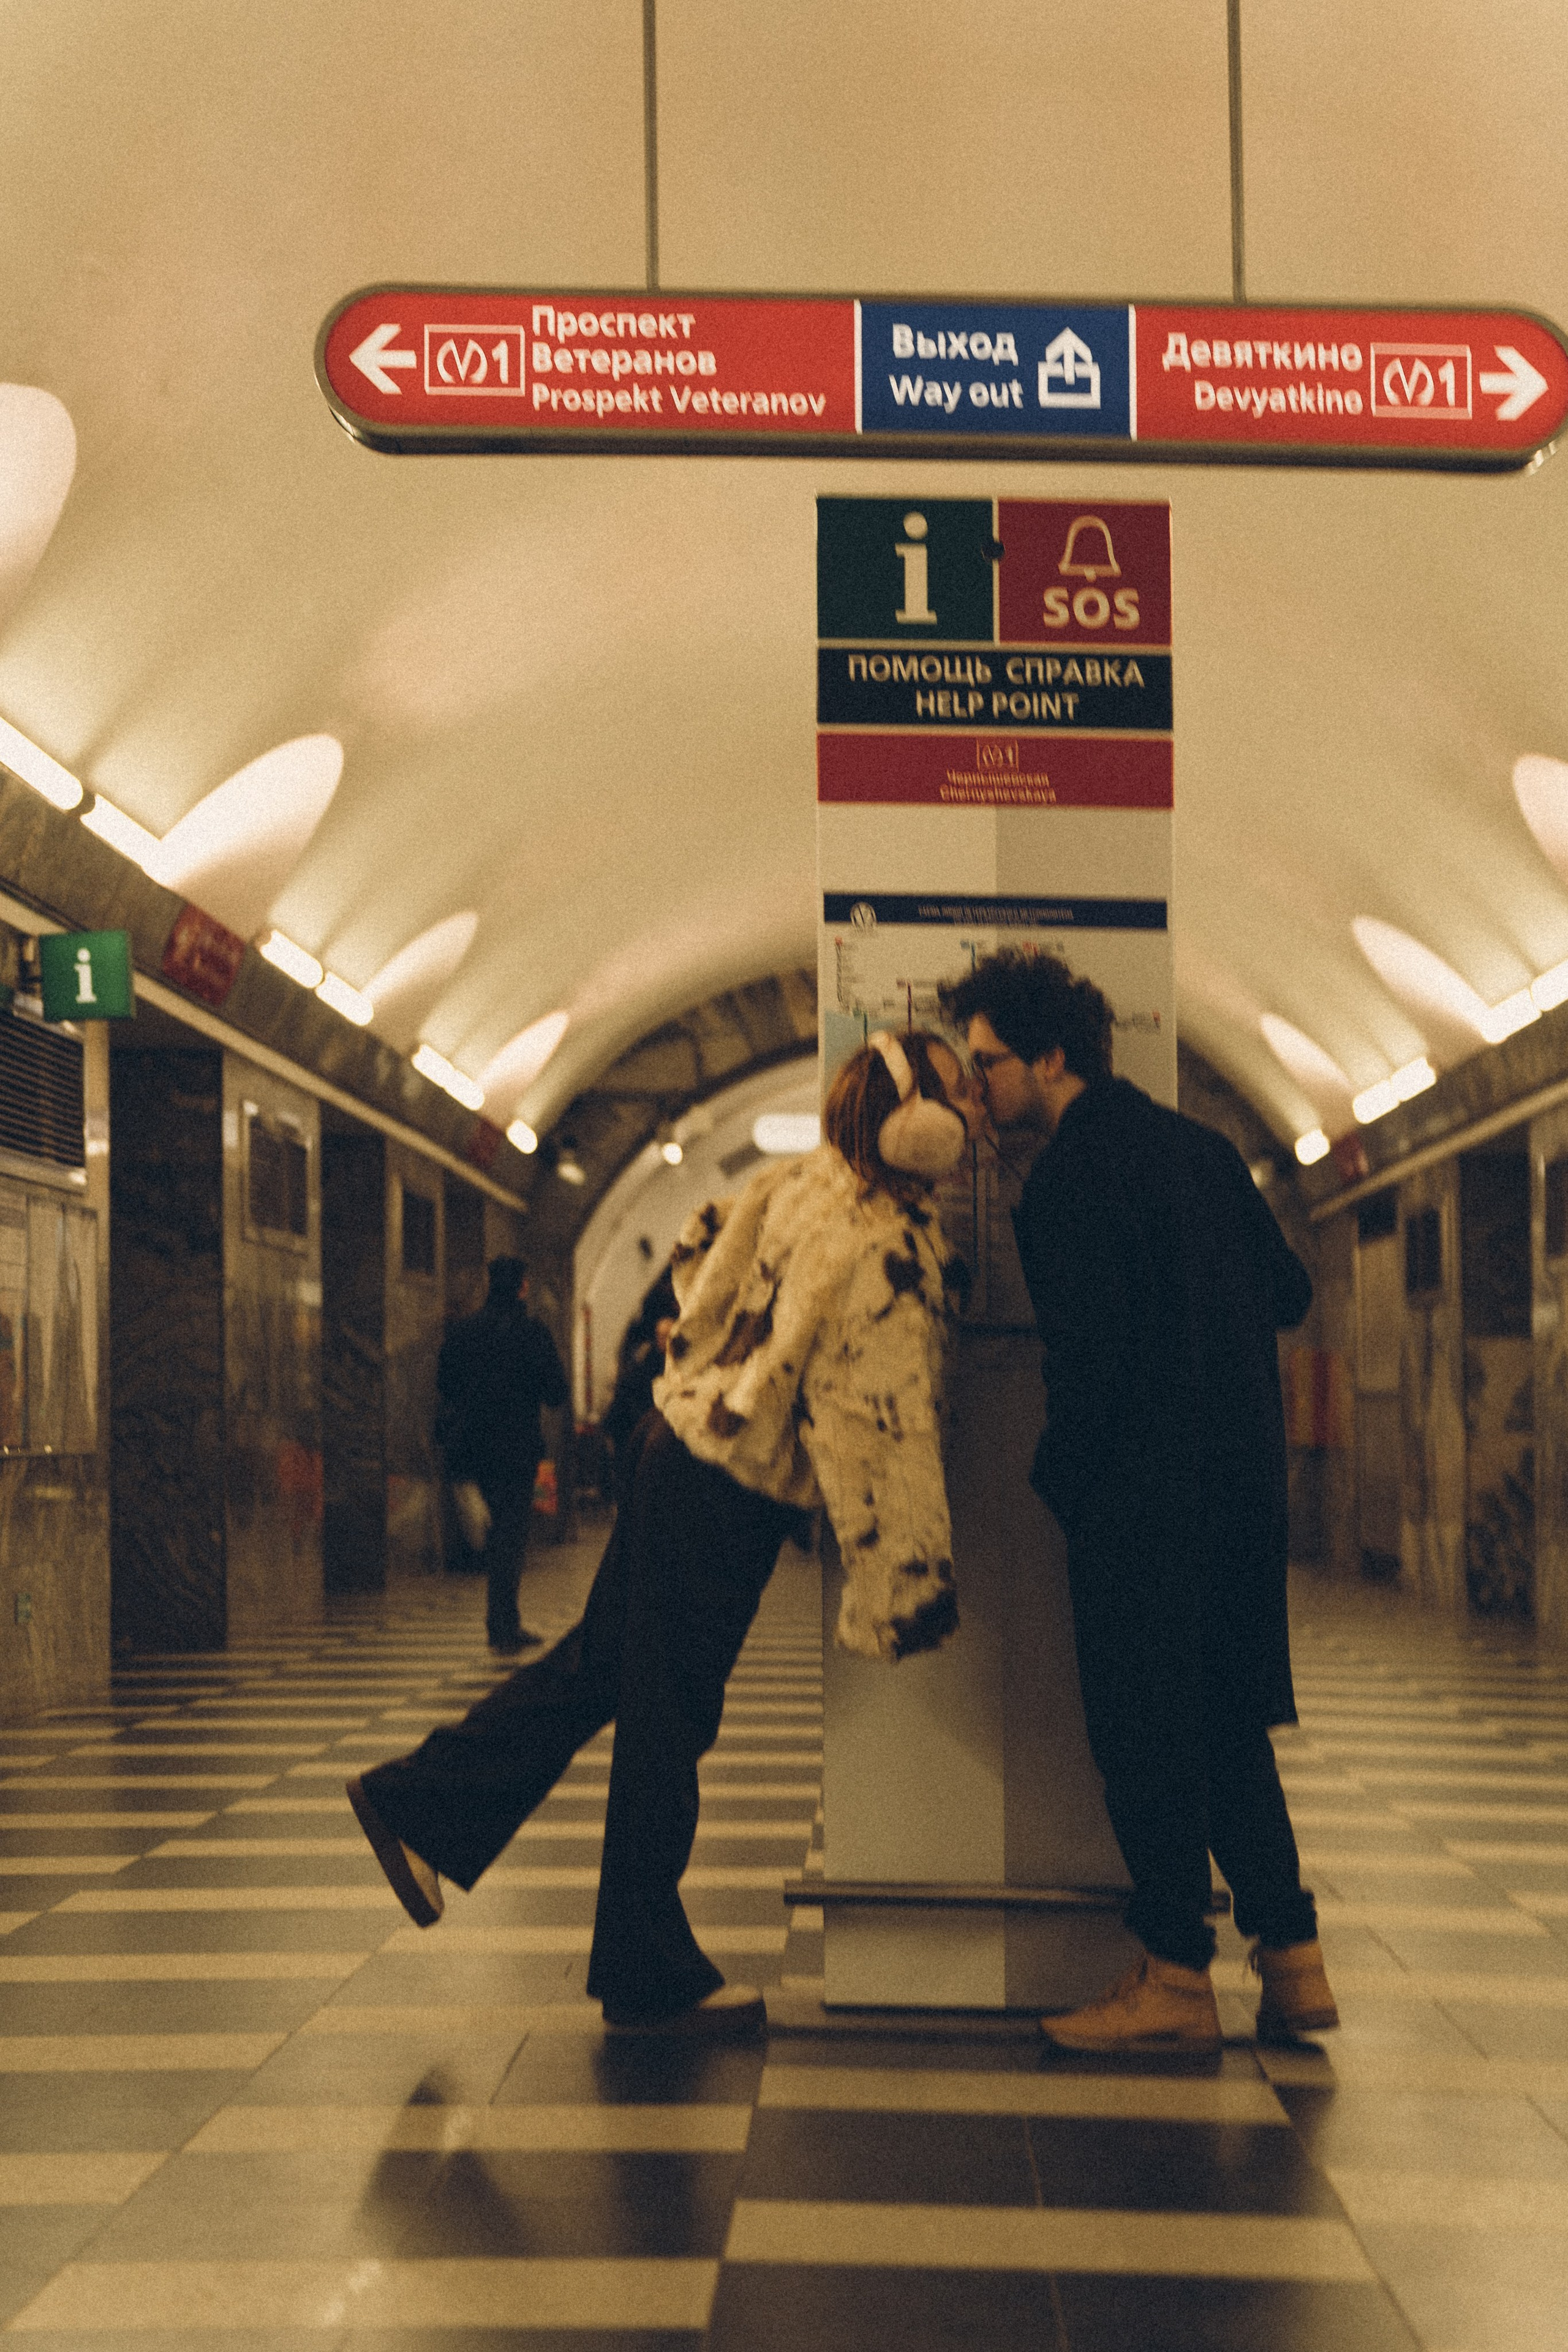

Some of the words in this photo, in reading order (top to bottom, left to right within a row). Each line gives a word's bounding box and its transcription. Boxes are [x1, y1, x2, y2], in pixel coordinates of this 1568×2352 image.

[532, 304, 696, 344] Проспект
[532, 341, 717, 382] Ветеранов
[892, 323, 1019, 366] Выход
[1163, 332, 1363, 372] Девяткино
[532, 382, 663, 419] Prospekt
[669, 383, 826, 417] Veteranov
[888, 374, 962, 414] Way
[969, 379, 1023, 409] out
[1194, 379, 1363, 419] Devyatkino
[1043, 586, 1140, 630] SOS
[848, 654, 992, 688] ПОМОЩЬ
[1006, 657, 1145, 687] СПРАВКА
[916, 689, 984, 718] HELP
[992, 690, 1079, 720] POINT
